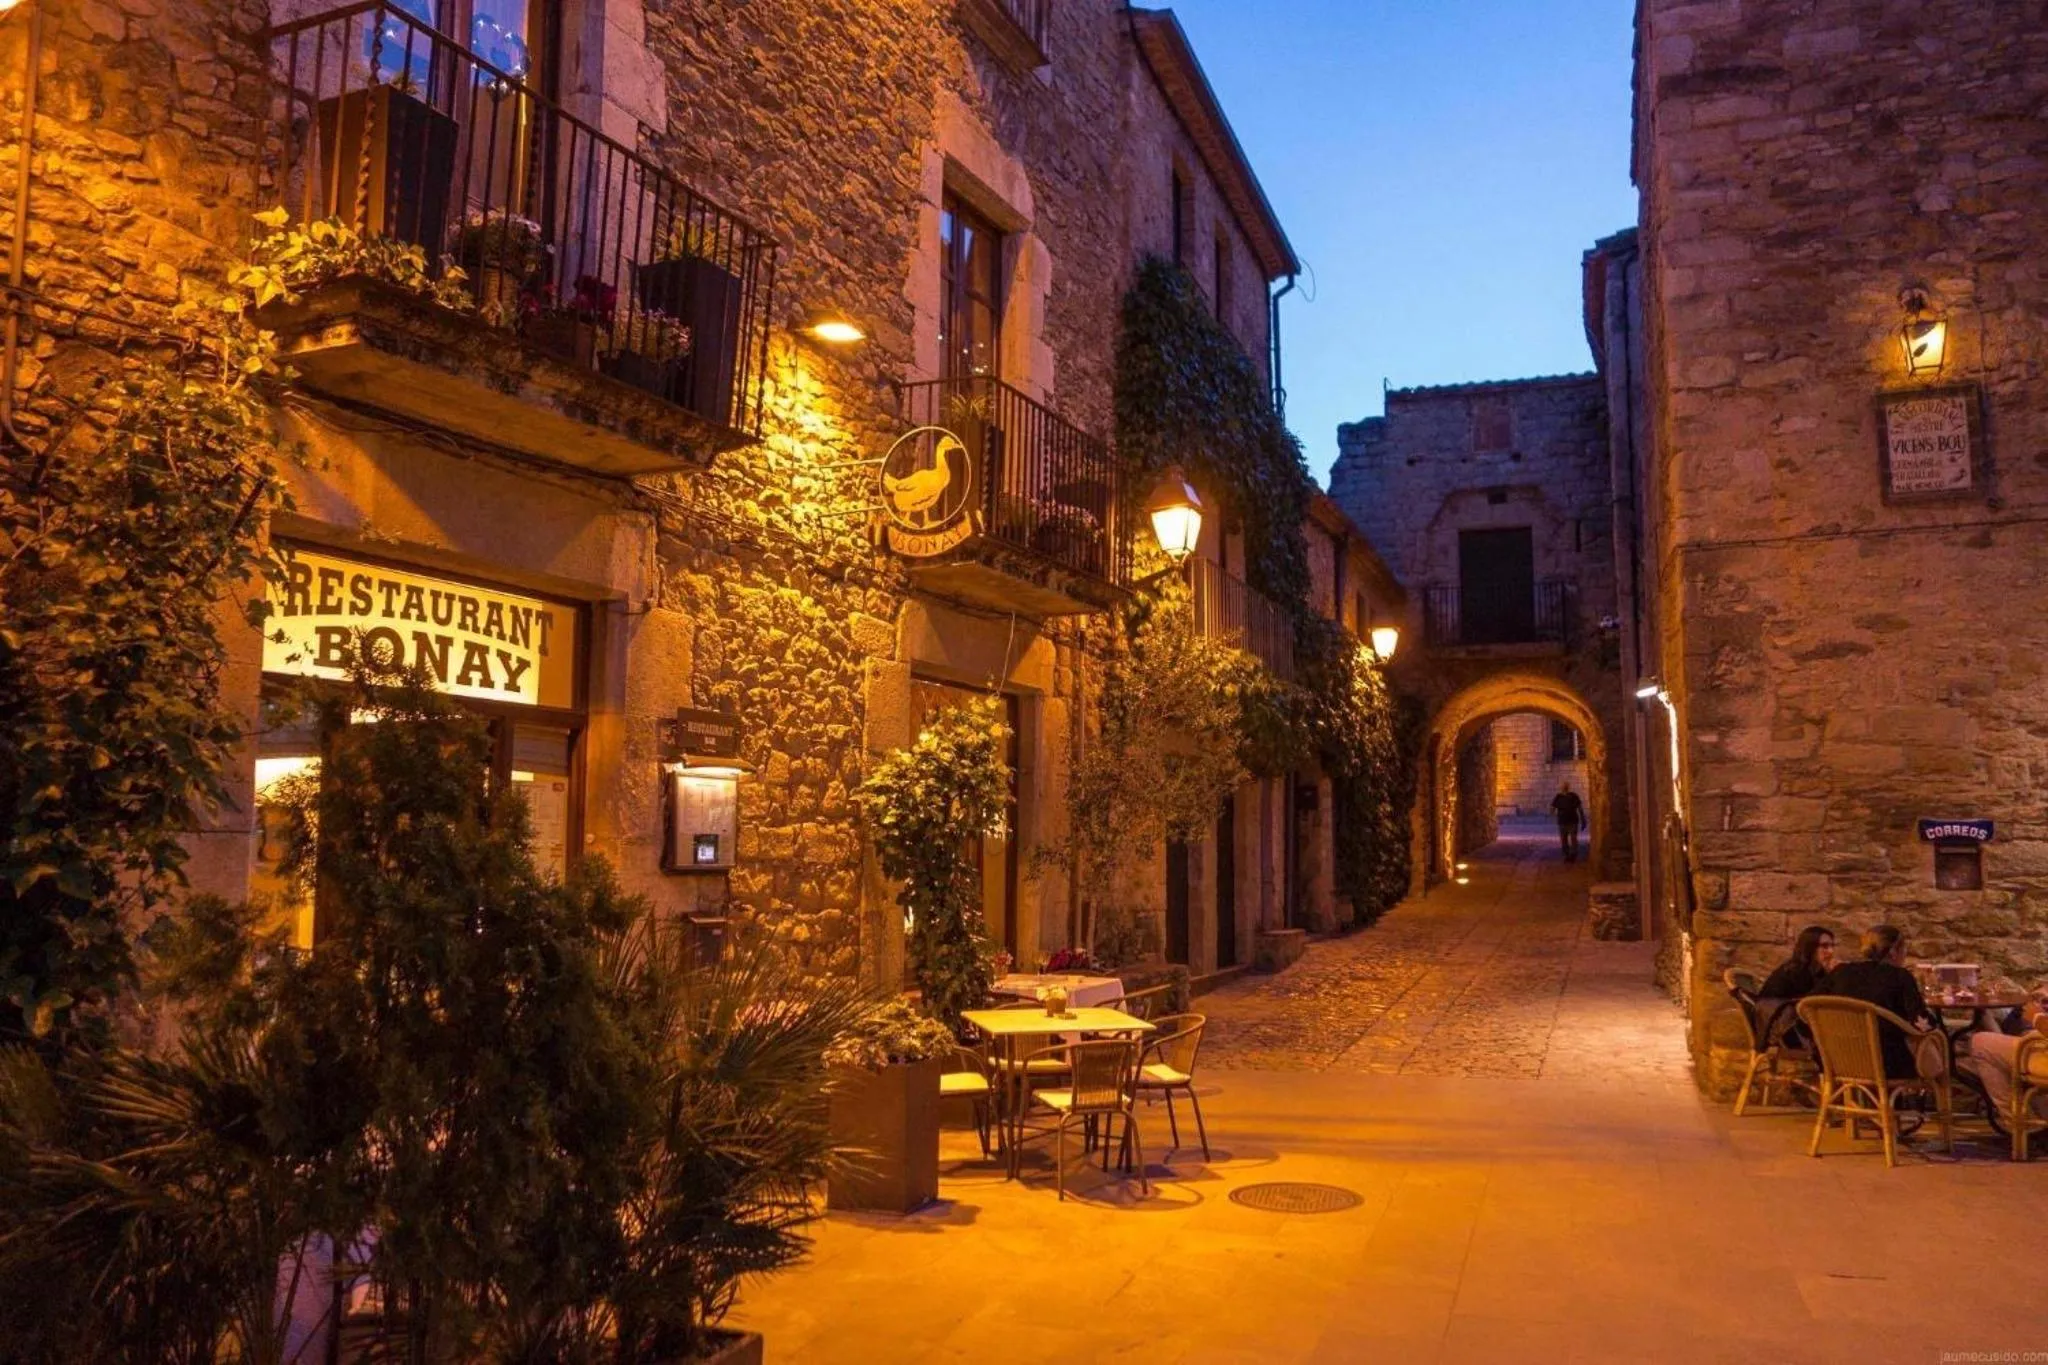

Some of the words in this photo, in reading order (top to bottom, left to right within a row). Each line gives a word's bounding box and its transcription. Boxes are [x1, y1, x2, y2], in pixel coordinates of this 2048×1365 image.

[1939, 435, 1966, 452] BOU
[283, 562, 554, 656] RESTAURANT
[313, 626, 531, 693] BONAY
[1925, 824, 1988, 840] CORREOS
